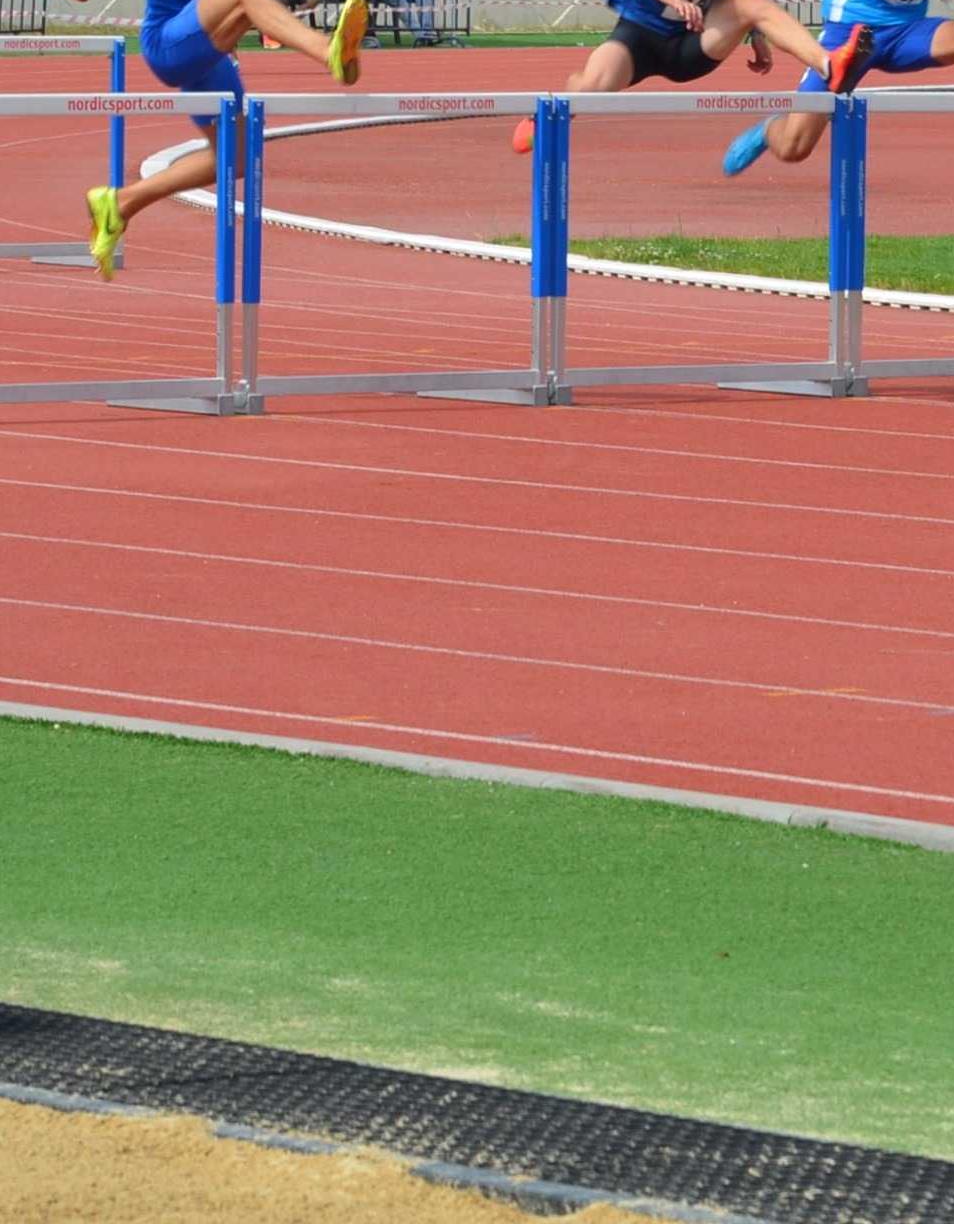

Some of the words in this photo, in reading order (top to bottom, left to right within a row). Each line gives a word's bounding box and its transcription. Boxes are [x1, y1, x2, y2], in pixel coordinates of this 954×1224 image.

[3, 39, 81, 51] nordicsport.com
[67, 97, 174, 113] nordicsport.com
[399, 97, 495, 113] nordicsport.com
[696, 95, 793, 111] nordicsport.com
